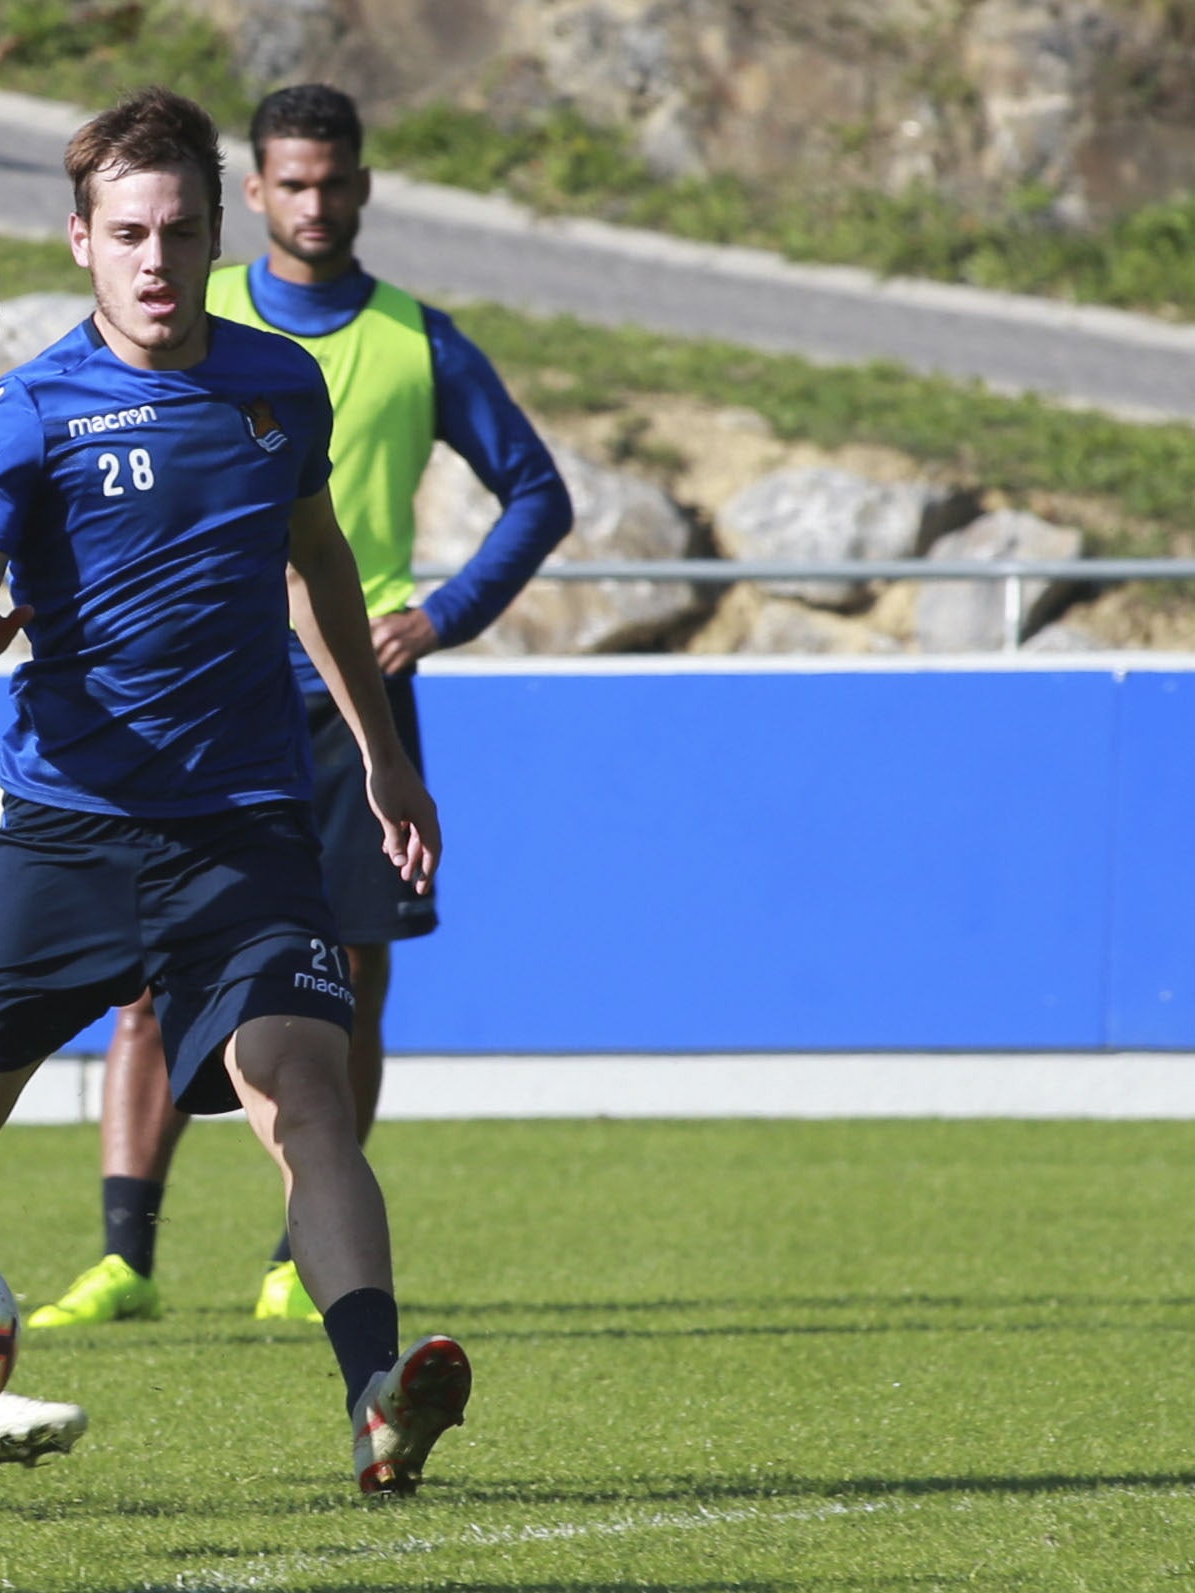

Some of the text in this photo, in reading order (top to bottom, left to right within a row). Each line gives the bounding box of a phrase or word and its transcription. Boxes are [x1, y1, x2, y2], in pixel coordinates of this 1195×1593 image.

[68, 405, 157, 438] macron
[98, 448, 155, 497] 28
[310, 938, 344, 980] 21
